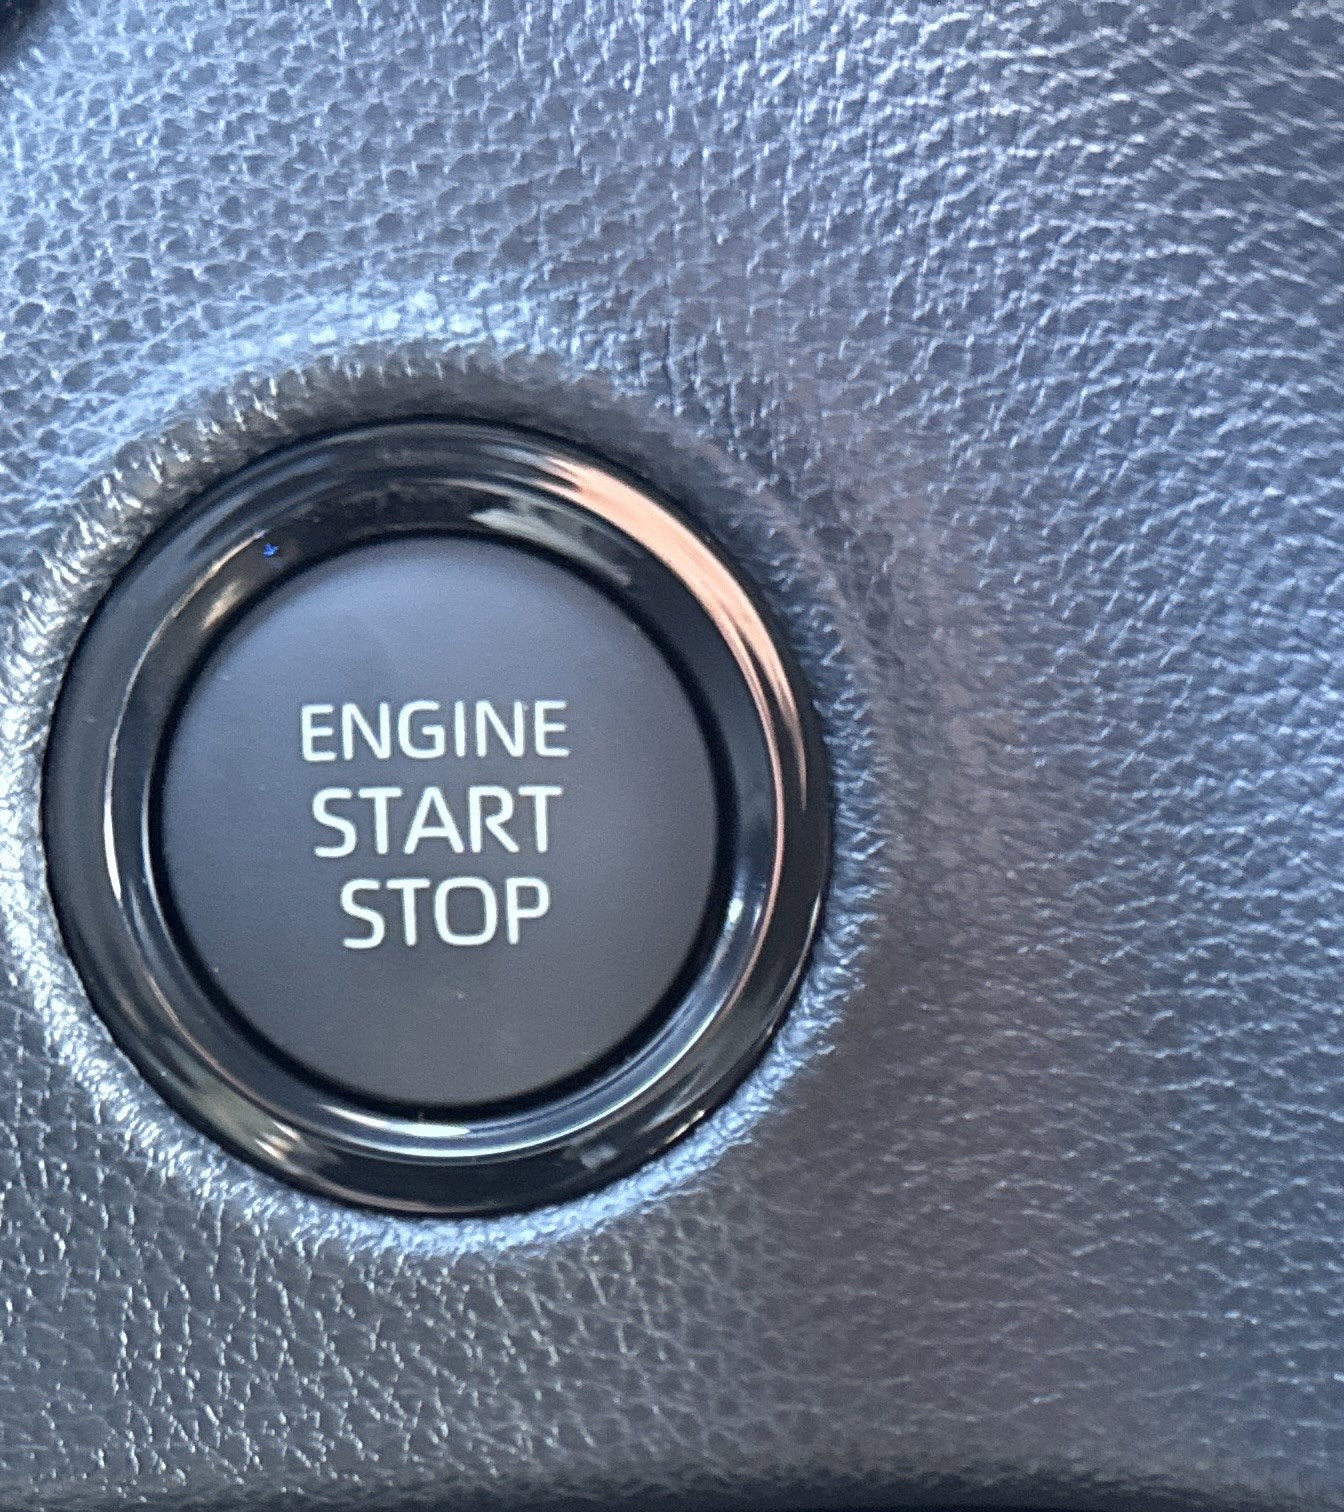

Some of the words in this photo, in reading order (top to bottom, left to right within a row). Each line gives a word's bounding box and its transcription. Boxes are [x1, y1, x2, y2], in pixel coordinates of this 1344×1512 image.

[299, 697, 573, 763] ENGINE
[310, 783, 565, 859] START
[338, 875, 552, 950] STOP
